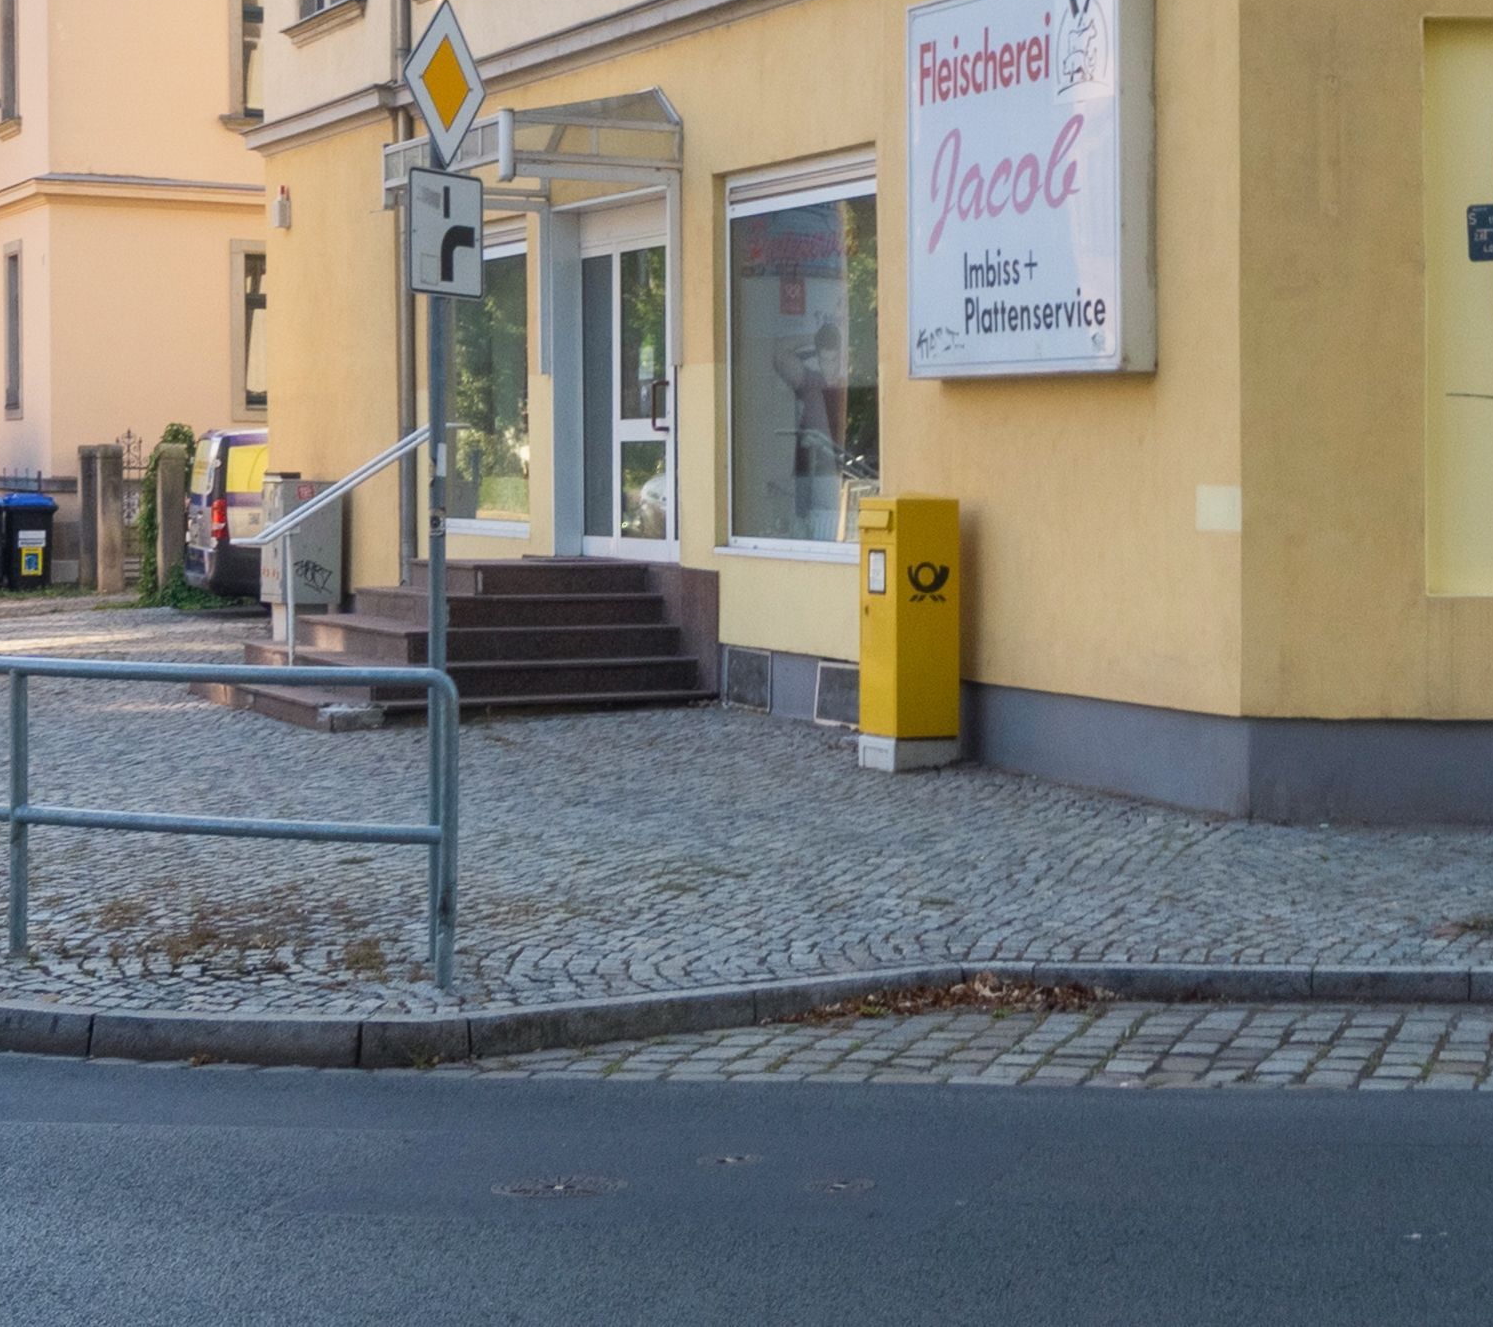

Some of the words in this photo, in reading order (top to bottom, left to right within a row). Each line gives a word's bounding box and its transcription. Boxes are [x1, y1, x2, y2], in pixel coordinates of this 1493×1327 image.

[919, 12, 1050, 106] Fleischerei
[928, 113, 1084, 254] Jacob
[1468, 213, 1477, 225] S
[963, 249, 1020, 290] Imbiss
[965, 287, 1106, 335] Plattenservice
